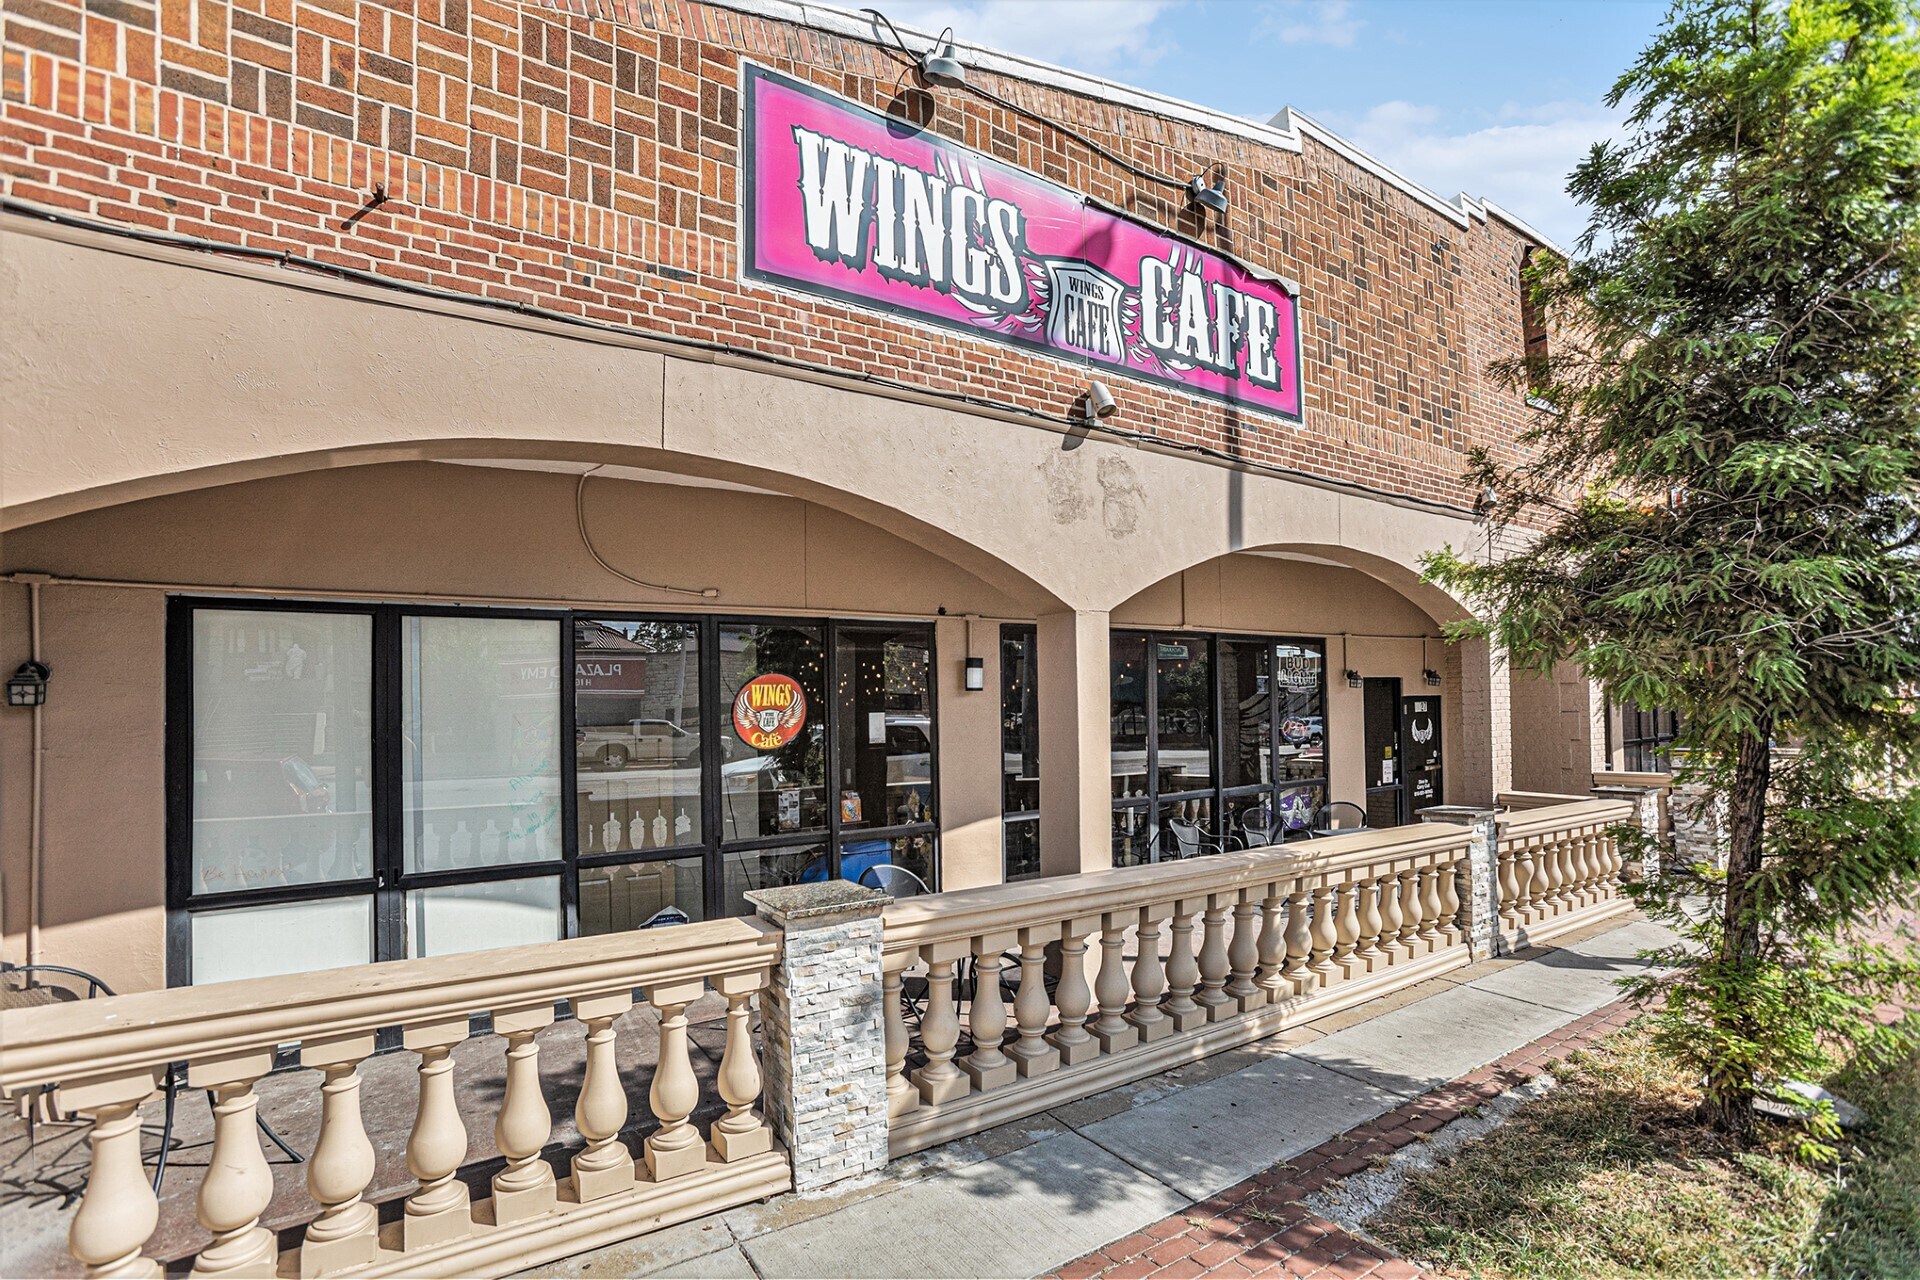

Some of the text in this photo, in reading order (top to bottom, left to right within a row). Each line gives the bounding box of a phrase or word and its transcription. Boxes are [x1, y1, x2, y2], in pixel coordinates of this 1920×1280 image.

[791, 125, 1279, 386] WINGS CAFE
[1068, 276, 1104, 300] WINGS
[1064, 294, 1110, 356] CAFE
[1286, 656, 1311, 671] BUD
[751, 684, 792, 707] WINGS
[750, 731, 783, 748] Café
